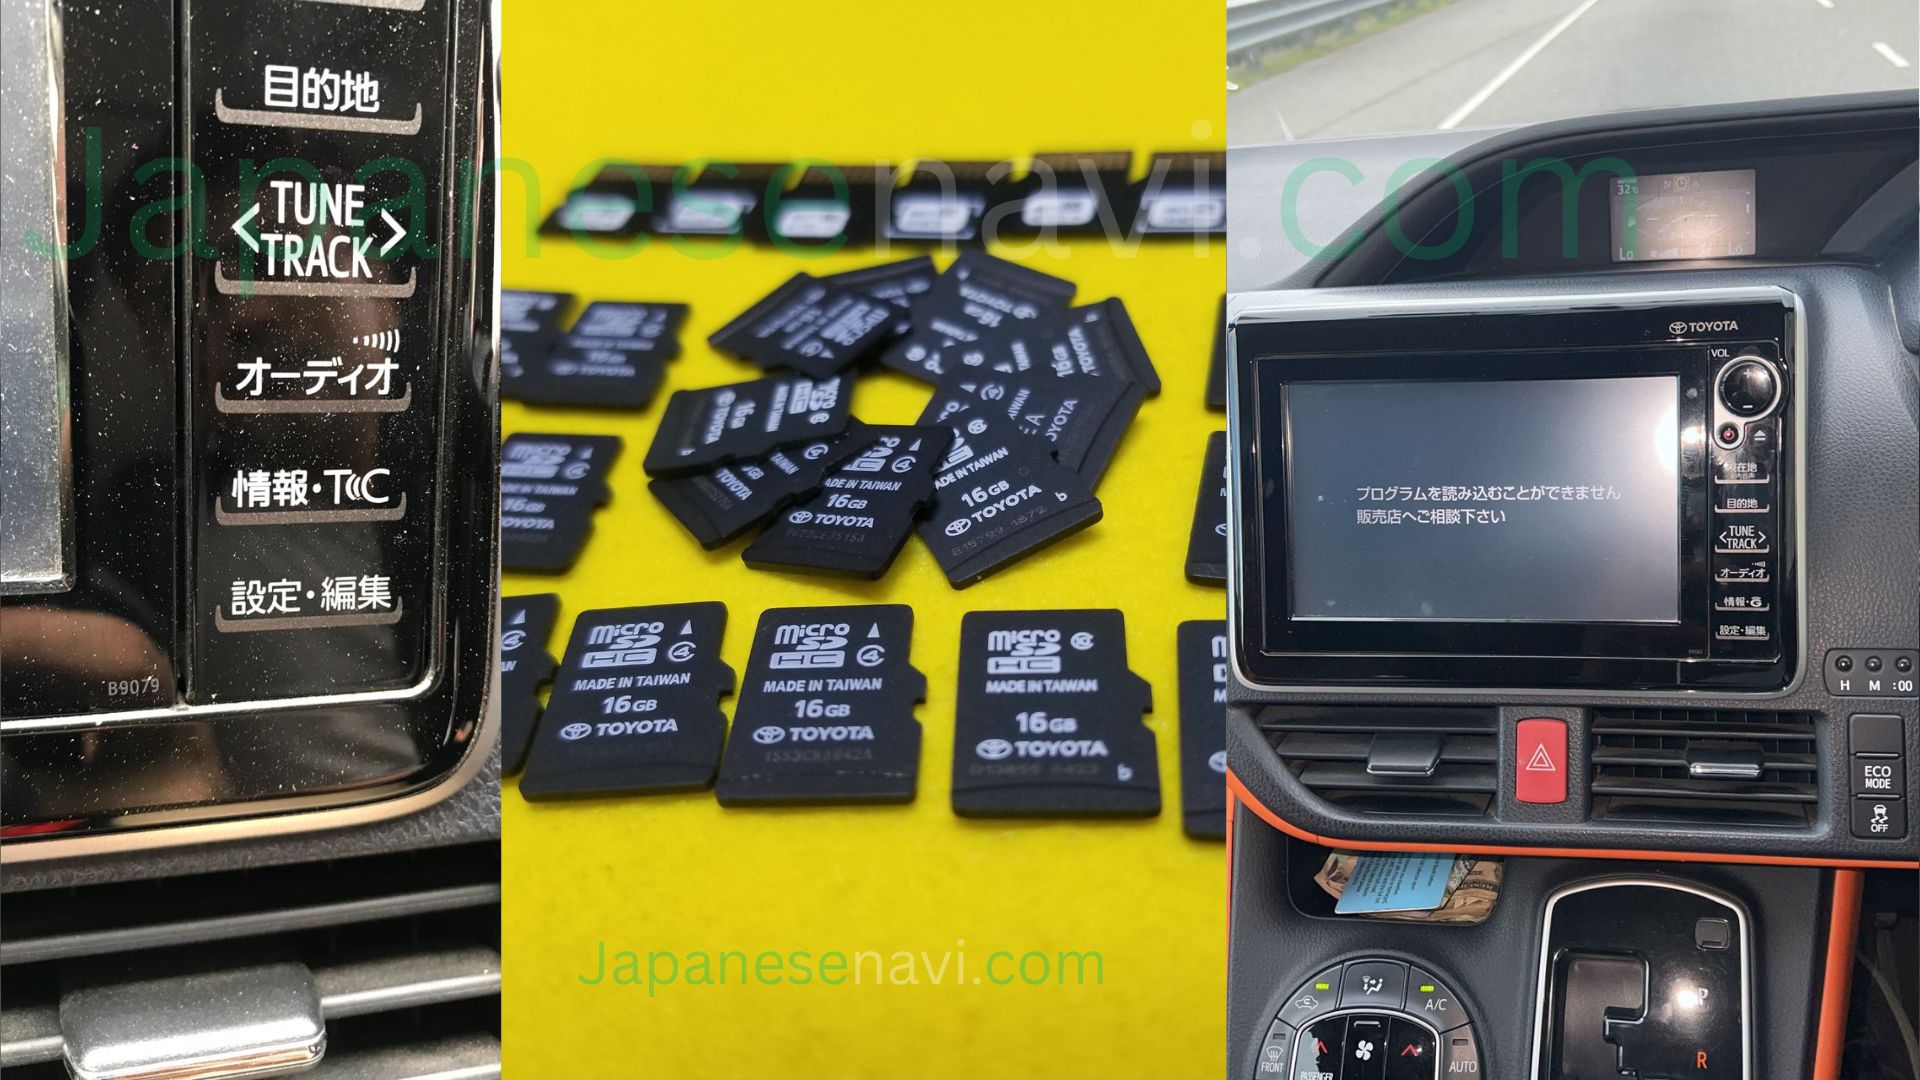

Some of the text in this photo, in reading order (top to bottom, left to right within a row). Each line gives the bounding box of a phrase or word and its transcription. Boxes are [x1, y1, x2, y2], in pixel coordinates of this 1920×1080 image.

[263, 64, 381, 113] 目的地
[270, 181, 366, 227] TUNE
[260, 233, 373, 279] TRACK
[1689, 320, 1739, 333] TOYOTA
[1711, 349, 1730, 358] VOL
[236, 355, 399, 397] オーディオ
[966, 446, 1009, 473] TAIWAN
[716, 467, 753, 501] TOYOTA
[859, 480, 902, 492] TAIWAN
[1356, 486, 1622, 502] プログラムを読み込むことができません
[970, 484, 1043, 523] TOYOTA
[1727, 498, 1758, 509] 目的地
[814, 513, 875, 529] TOYOTA
[1356, 509, 1507, 525] 販売店へご相談下さい
[1729, 525, 1755, 537] TUNE
[1726, 538, 1757, 549] TRACK
[1720, 568, 1766, 579] オーディオ
[230, 574, 392, 616] 設定・編集
[588, 621, 665, 645] micro
[774, 623, 850, 645] micro
[987, 629, 1061, 651] micro
[108, 678, 160, 696] B9079
[573, 672, 691, 691] MADE IN TAIWAN
[763, 677, 882, 693] MADE IN TAIWAN
[985, 679, 1098, 694] MADE IN TAIWAN
[1840, 680, 1850, 691] H
[1869, 680, 1880, 691] M
[596, 718, 679, 737] TOYOTA
[789, 725, 874, 742] TOYOTA
[1014, 740, 1109, 757] TOYOTA
[1864, 765, 1891, 777] ECO
[1865, 778, 1891, 789] MODE
[1870, 824, 1889, 832] OFF
[1425, 998, 1447, 1011] A/C
[1261, 1062, 1284, 1073] FRONT
[1449, 1061, 1477, 1073] AUTO
[1696, 1051, 1708, 1069] R
